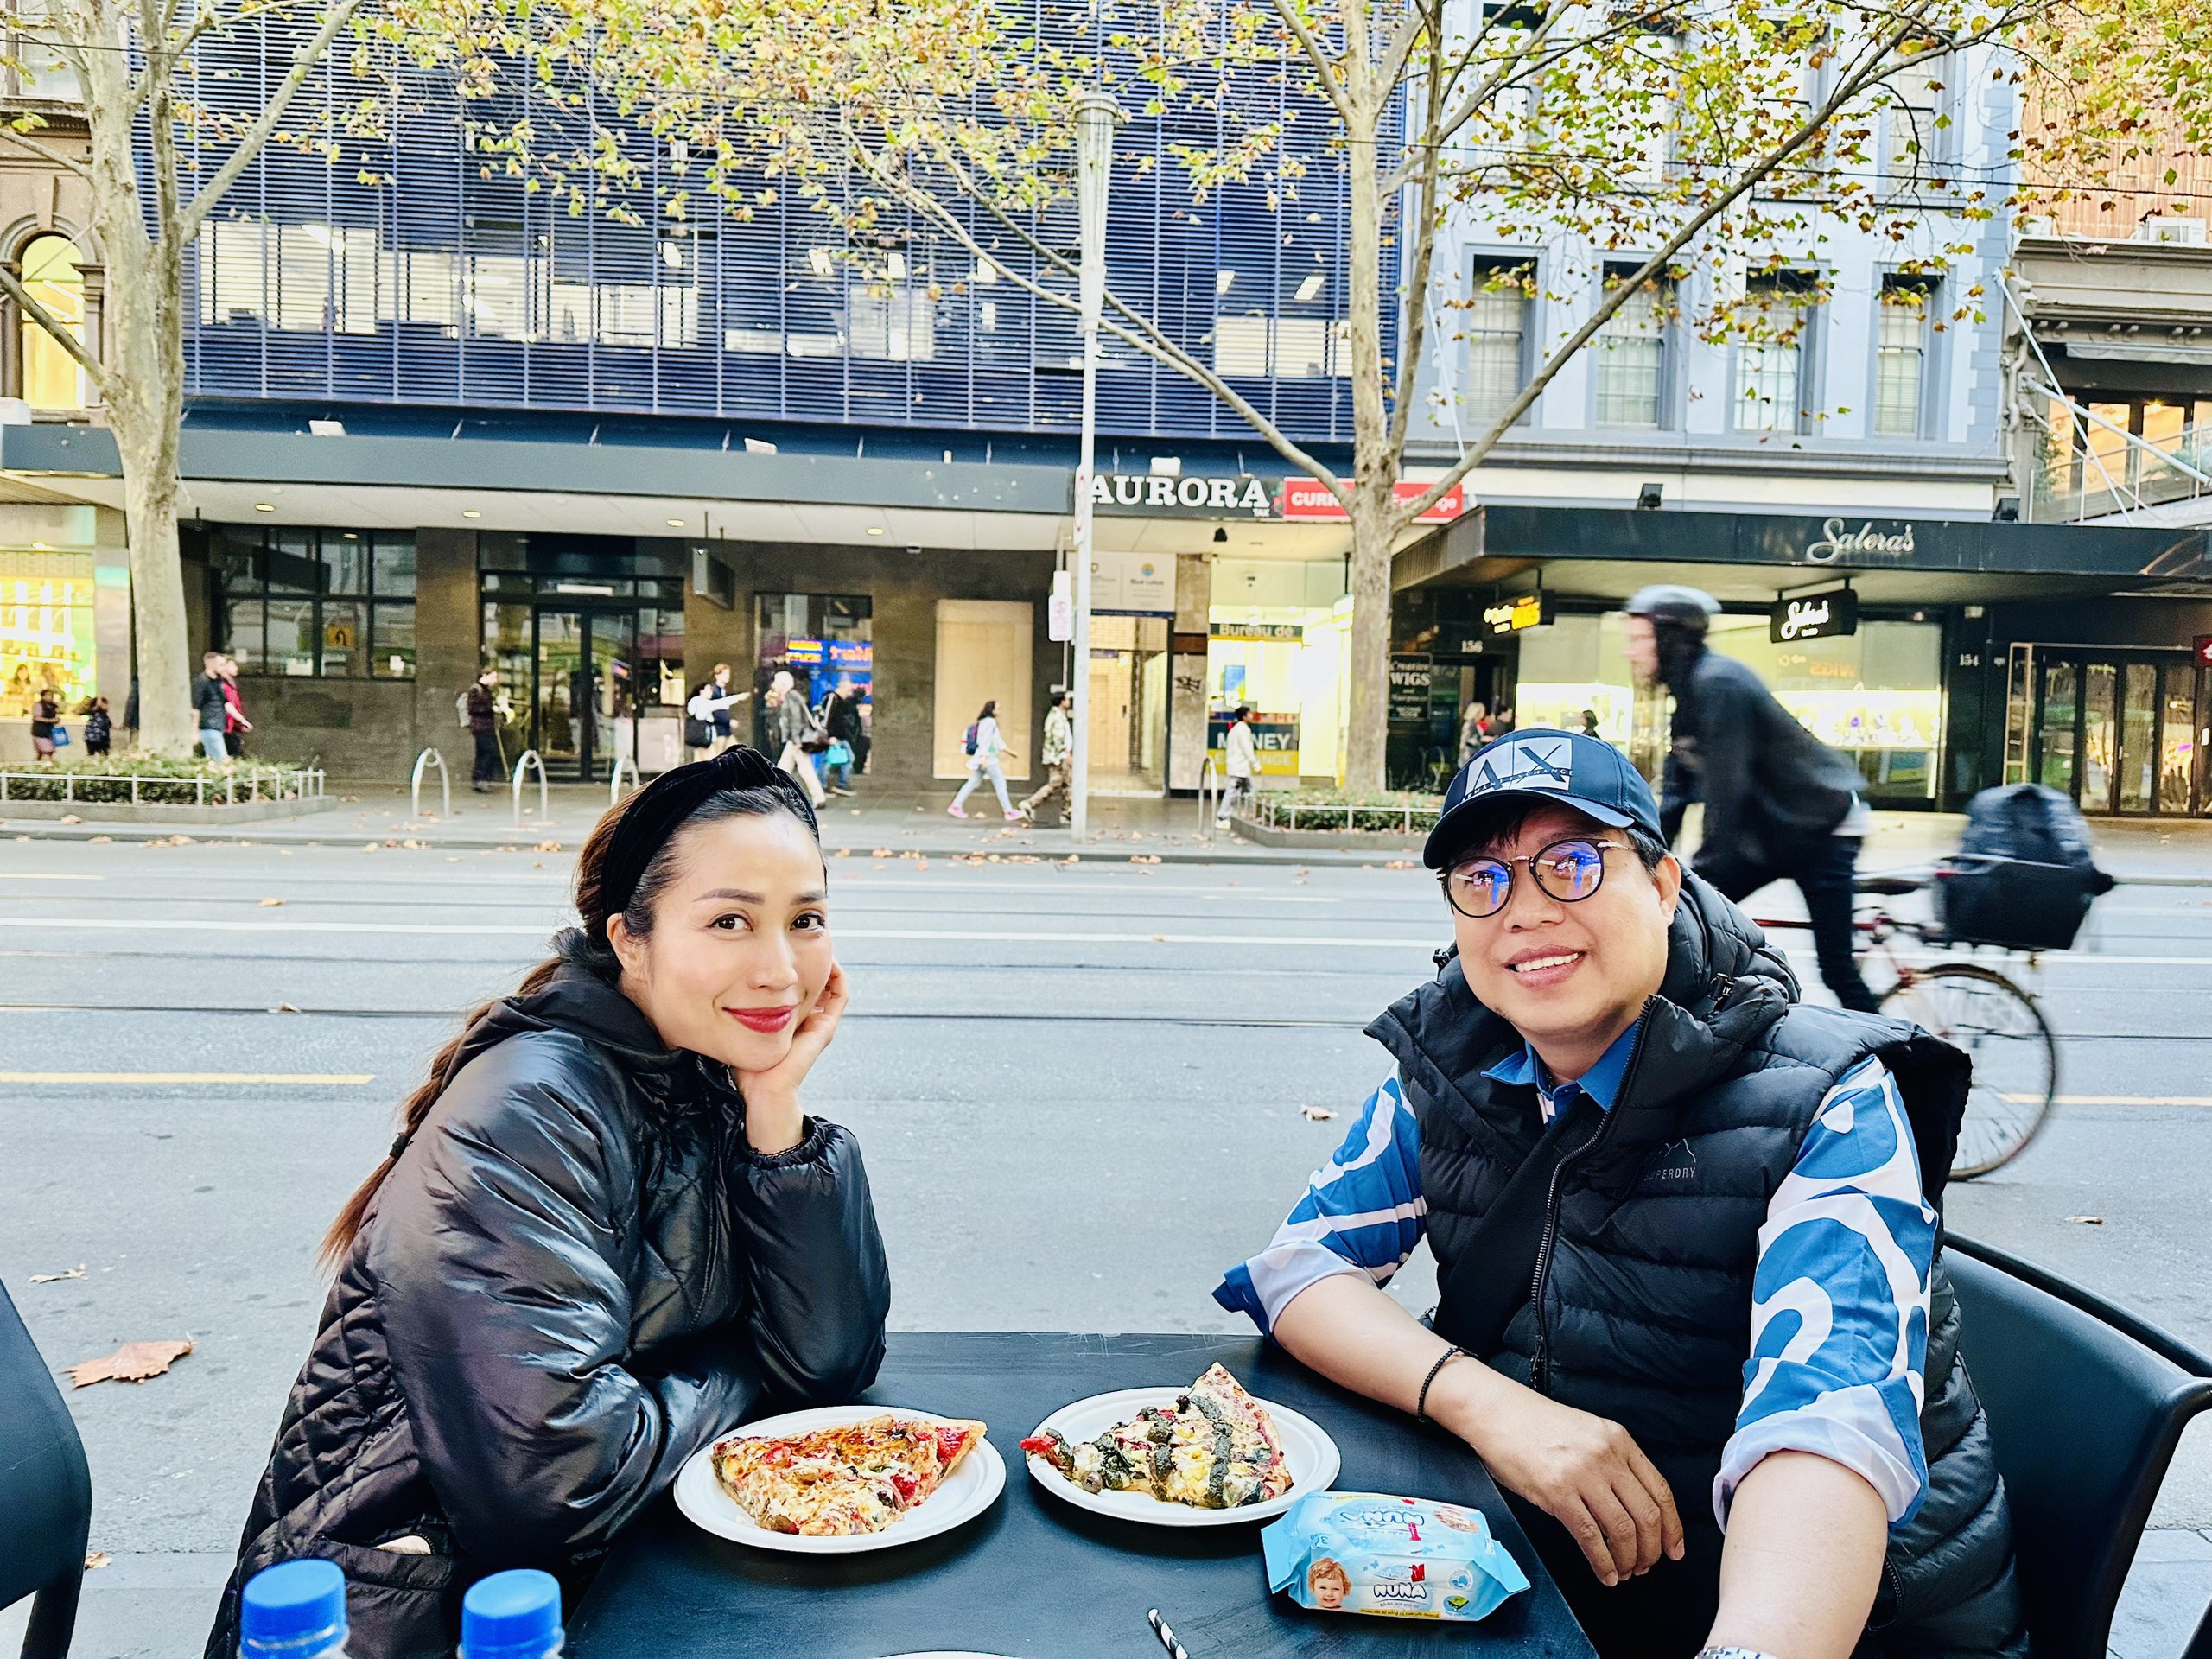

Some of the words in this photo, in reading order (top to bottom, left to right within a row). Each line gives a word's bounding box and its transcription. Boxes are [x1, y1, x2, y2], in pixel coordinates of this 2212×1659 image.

[1092, 475, 1270, 508] AURORA
[1291, 491, 1340, 507] CURR
[1219, 625, 1273, 636] Bureau
[1274, 626, 1294, 637] de
[1461, 640, 1484, 653] 156
[1390, 672, 1431, 686] WIGS
[1217, 732, 1291, 750] MNEY
